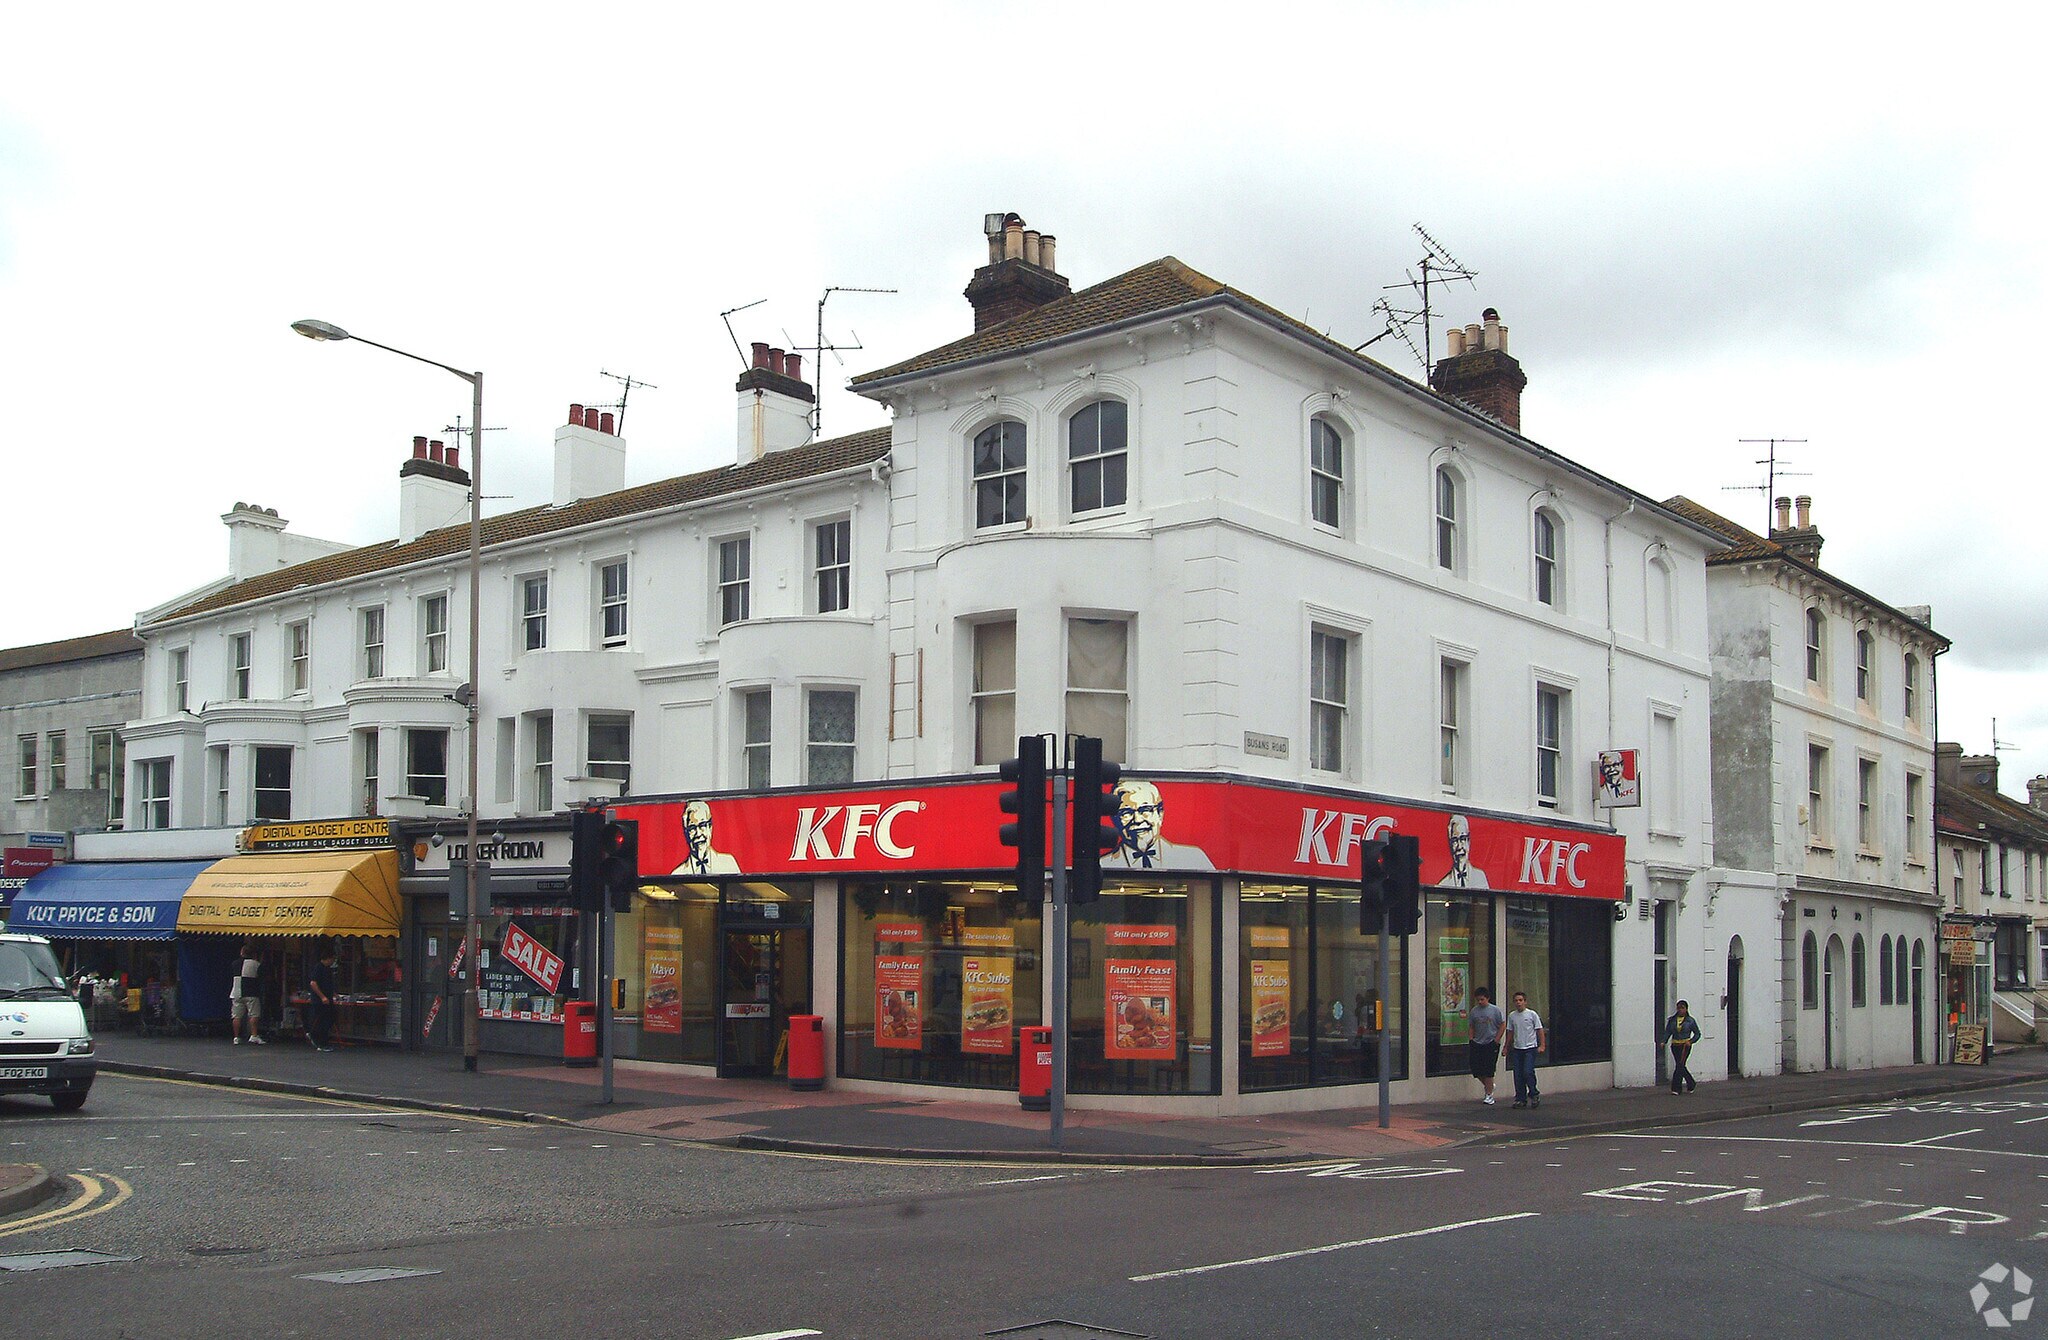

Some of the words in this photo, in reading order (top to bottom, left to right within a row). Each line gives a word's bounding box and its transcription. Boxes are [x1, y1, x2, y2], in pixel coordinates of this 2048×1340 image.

[1246, 738, 1270, 750] SUSANS
[1271, 742, 1287, 753] ROAD
[1619, 787, 1635, 798] KFC
[262, 827, 297, 838] DIGITAL
[304, 824, 345, 837] GADGET
[500, 841, 544, 860] ROOM
[11, 859, 48, 867] Pioneer
[1518, 836, 1590, 889] KFC
[27, 905, 56, 921] KUT
[58, 906, 106, 923] PRYCE
[108, 907, 118, 923] &
[122, 906, 156, 923] SON
[189, 905, 221, 917] DIGITAL
[228, 906, 269, 918] GADGET
[274, 906, 315, 918] CENTRE
[1114, 930, 1129, 938] Still
[508, 932, 558, 987] SALE
[879, 961, 900, 971] Family
[901, 961, 920, 970] Feast
[650, 963, 676, 978] Mayo
[1109, 965, 1143, 976] Family
[1144, 965, 1172, 975] Feast
[965, 972, 985, 983] KFC
[987, 972, 1010, 984] Subs
[1253, 975, 1268, 987] KFC
[1269, 976, 1288, 987] Subs
[1254, 1163, 1464, 1179] NO
